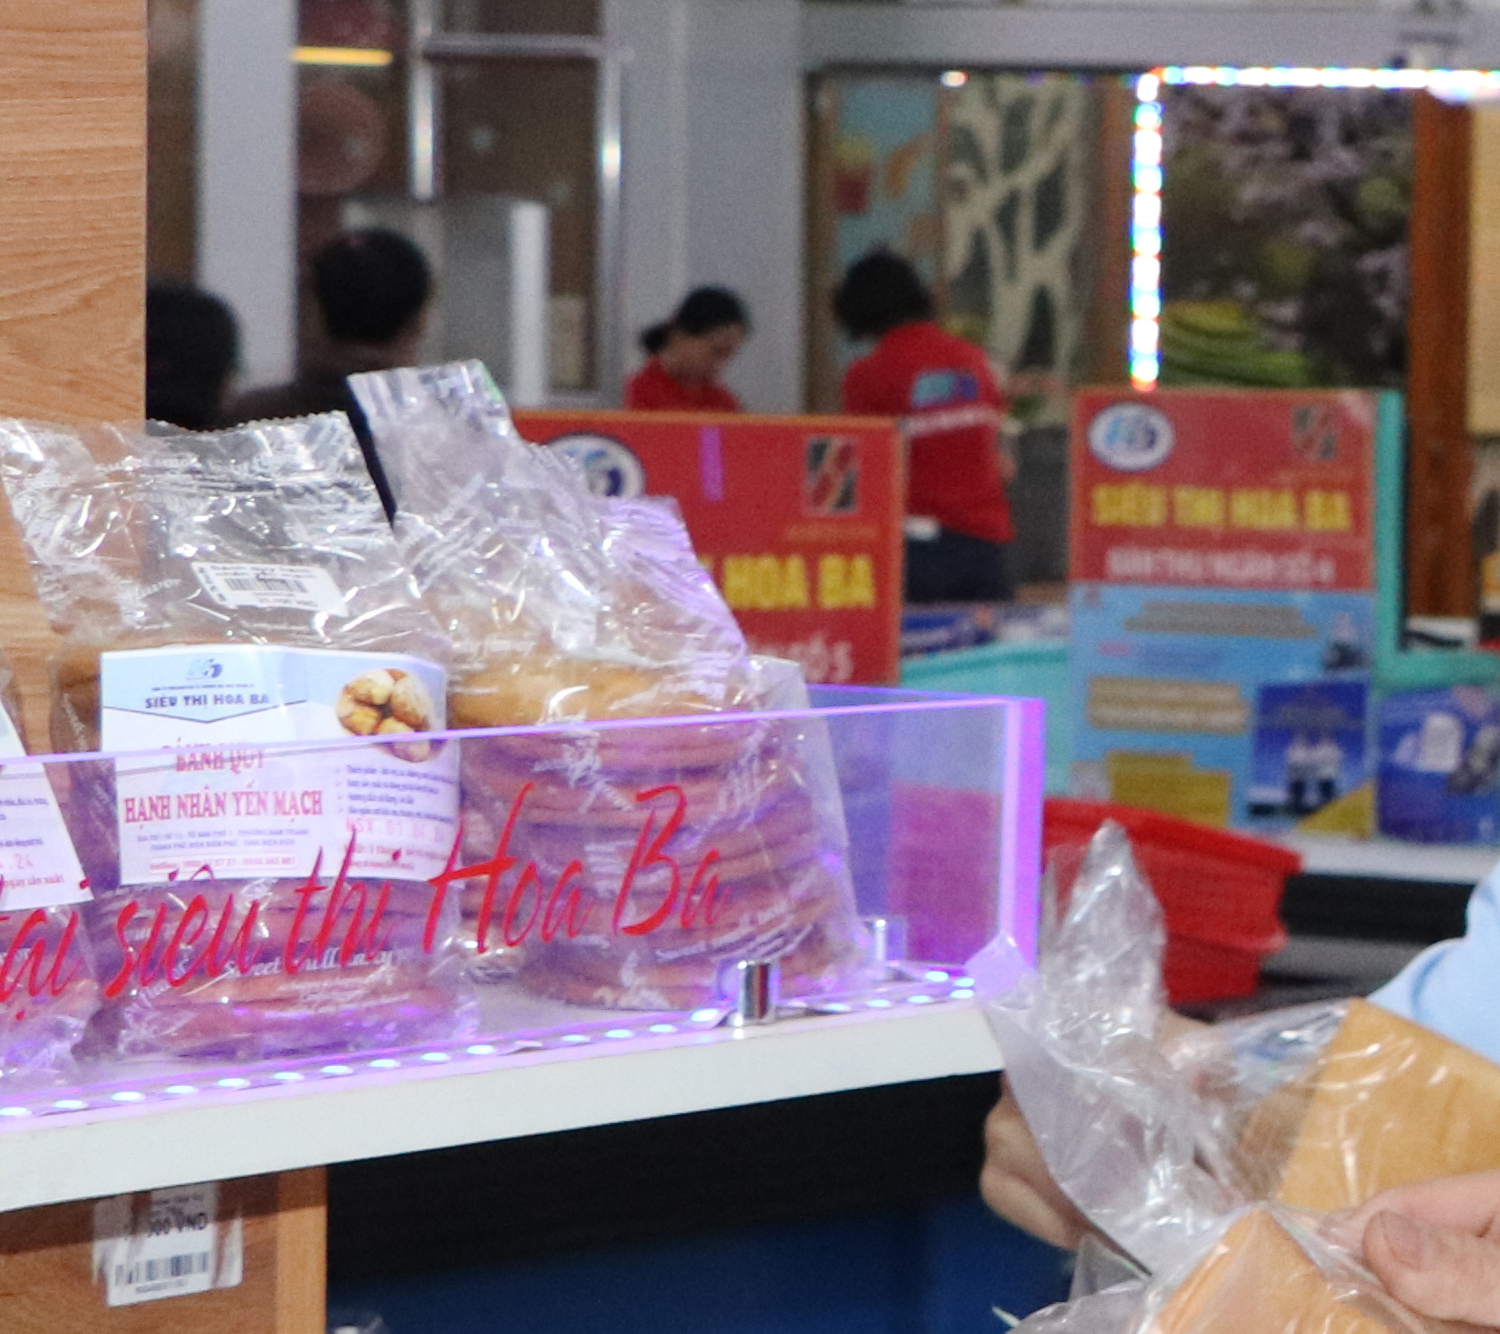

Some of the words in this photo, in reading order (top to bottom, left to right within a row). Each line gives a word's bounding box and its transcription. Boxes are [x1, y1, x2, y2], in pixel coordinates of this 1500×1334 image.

[1092, 480, 1169, 528] SIÊU
[1229, 488, 1298, 530] HOA
[1304, 491, 1352, 532] BA
[722, 554, 808, 610] HOA
[816, 553, 876, 610] BA
[123, 797, 172, 830] HẠNH
[177, 783, 226, 818] NHÂN
[232, 780, 268, 817] YẾN
[273, 789, 324, 824] MẠCH
[104, 864, 264, 1000] siêu
[422, 782, 595, 955] Hoa
[612, 783, 732, 935] Ba
